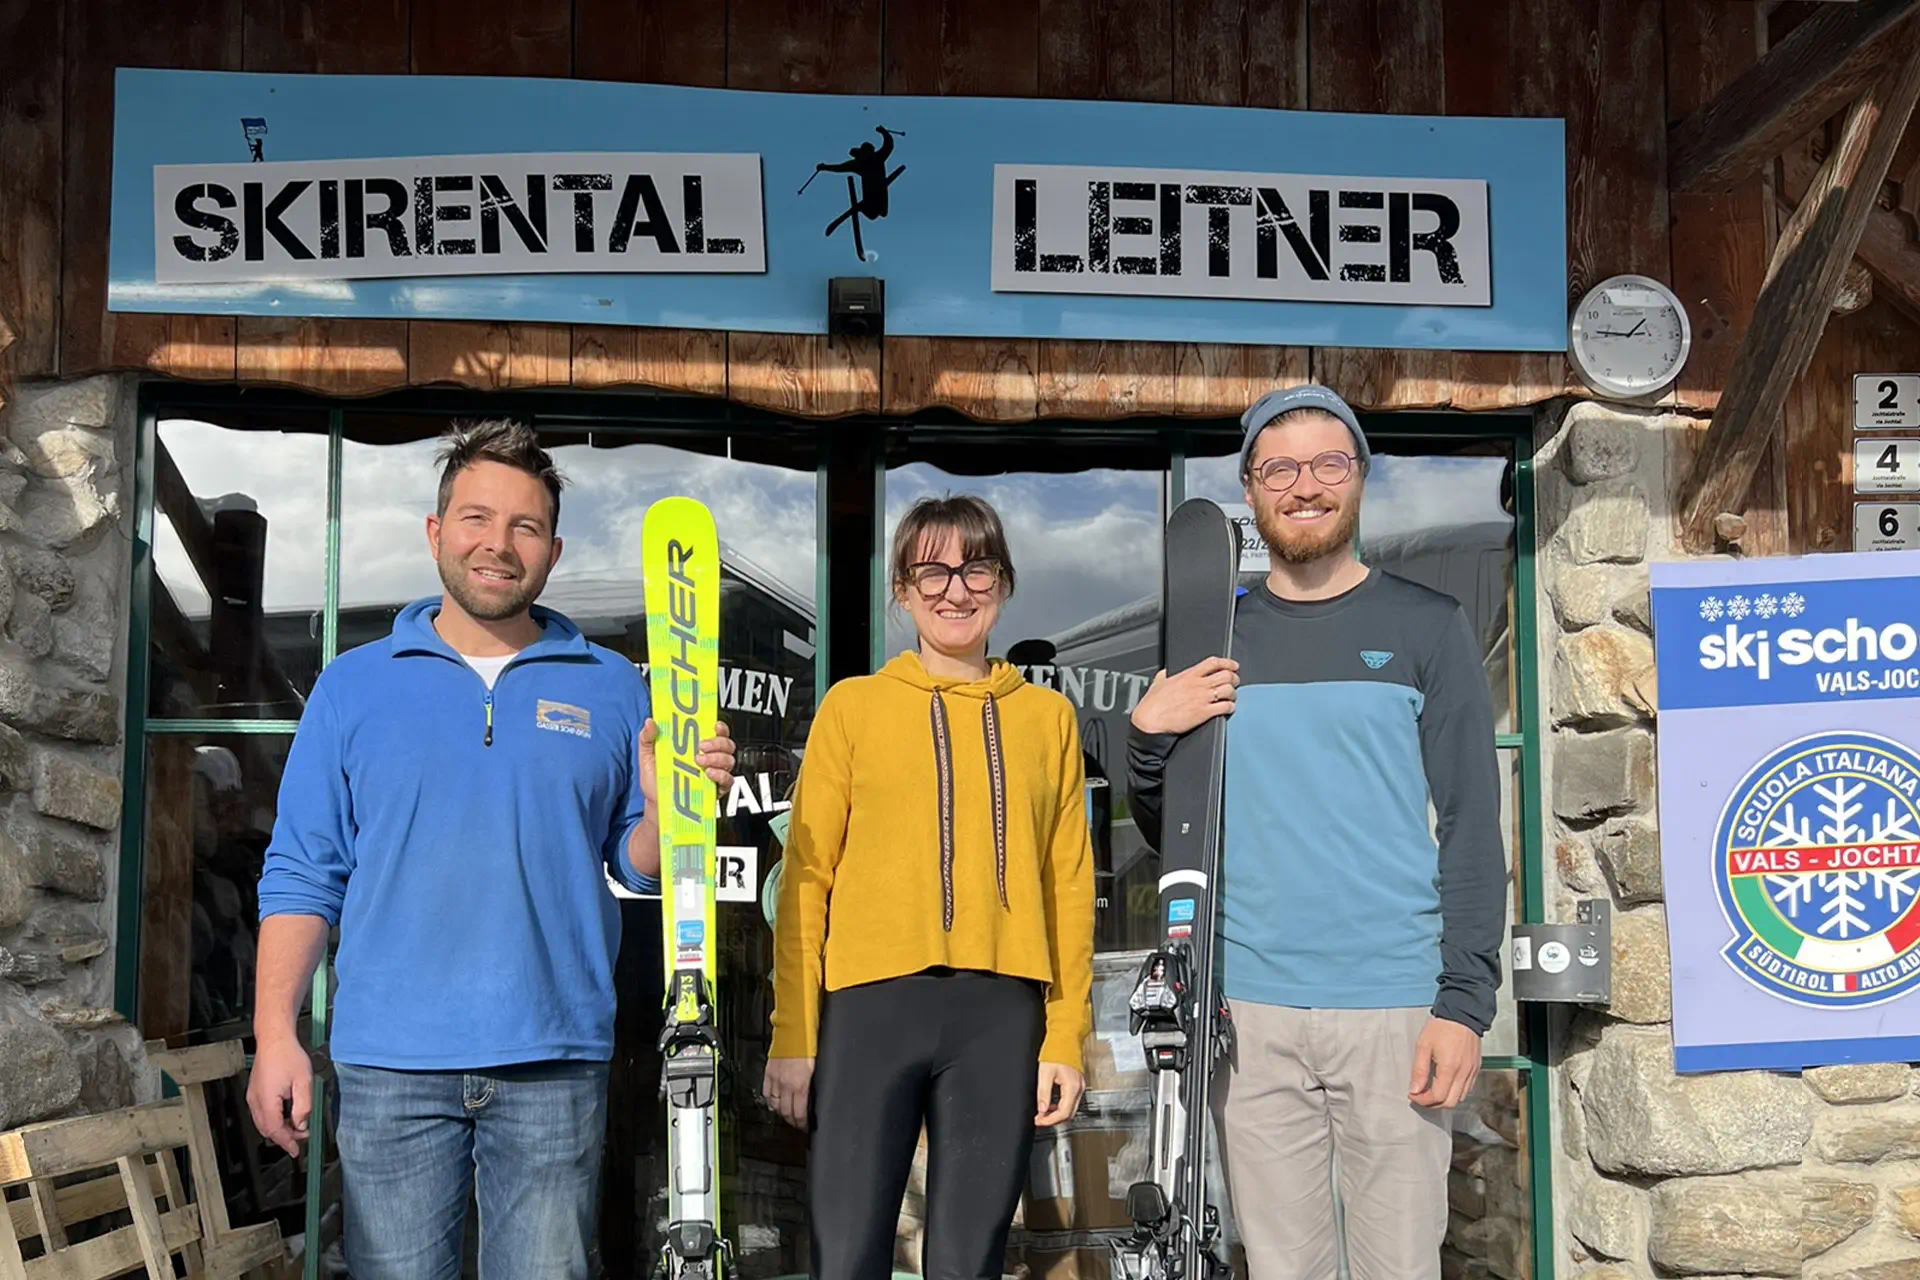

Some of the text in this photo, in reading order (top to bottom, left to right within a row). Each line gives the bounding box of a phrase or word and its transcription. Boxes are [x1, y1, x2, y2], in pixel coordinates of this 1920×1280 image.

[173, 174, 1465, 285] SKIRENTAL LEITNER
[1588, 310, 1599, 320] 10
[1877, 379, 1898, 409] 2
[1876, 444, 1900, 473] 4
[1878, 507, 1899, 537] 6
[1776, 617, 1920, 666] scho
[667, 538, 703, 825] FISCHER
[718, 666, 794, 719] MEN
[1018, 664, 1151, 715] ENUT
[1815, 667, 1920, 694] VALS-JOC
[716, 772, 793, 819] AL
[1737, 751, 1919, 842] SCUOLA ITALIANA
[1733, 850, 1801, 872] VALS
[1748, 945, 1829, 991] SÜDTIROL
[1861, 966, 1899, 989] ALTO
